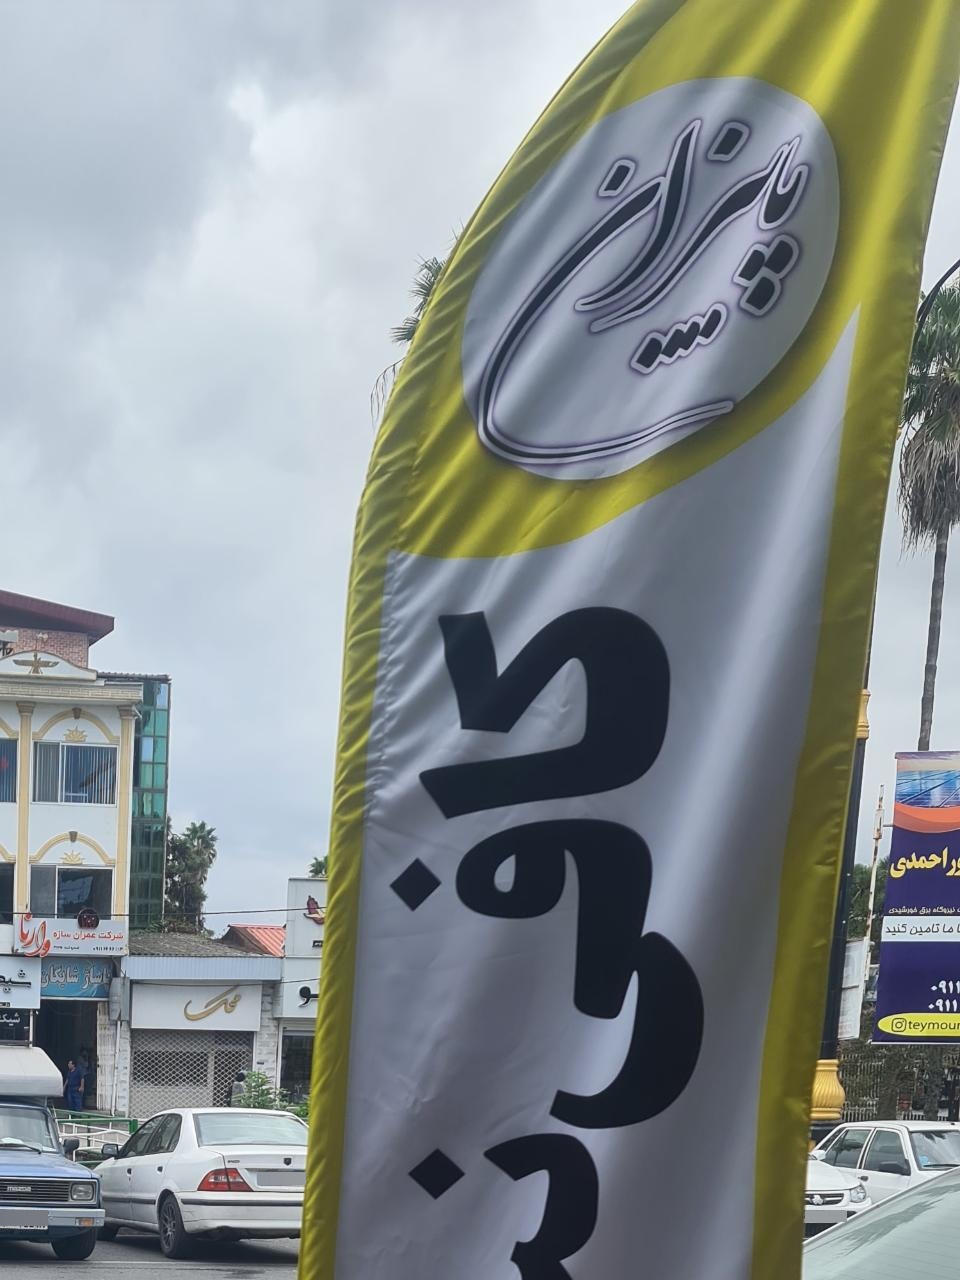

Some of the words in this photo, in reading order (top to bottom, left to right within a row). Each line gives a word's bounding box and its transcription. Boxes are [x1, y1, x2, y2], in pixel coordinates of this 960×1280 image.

[890, 846, 948, 878] احمدی
[390, 606, 704, 1129] کافی
[888, 906, 918, 914] خورشیدی
[919, 906, 931, 915] برق
[885, 923, 907, 936] کنید
[910, 923, 940, 936] تامین
[943, 923, 954, 933] ما
[53, 930, 71, 940] سازه
[73, 930, 96, 940] عمران
[98, 930, 124, 941] شرکت
